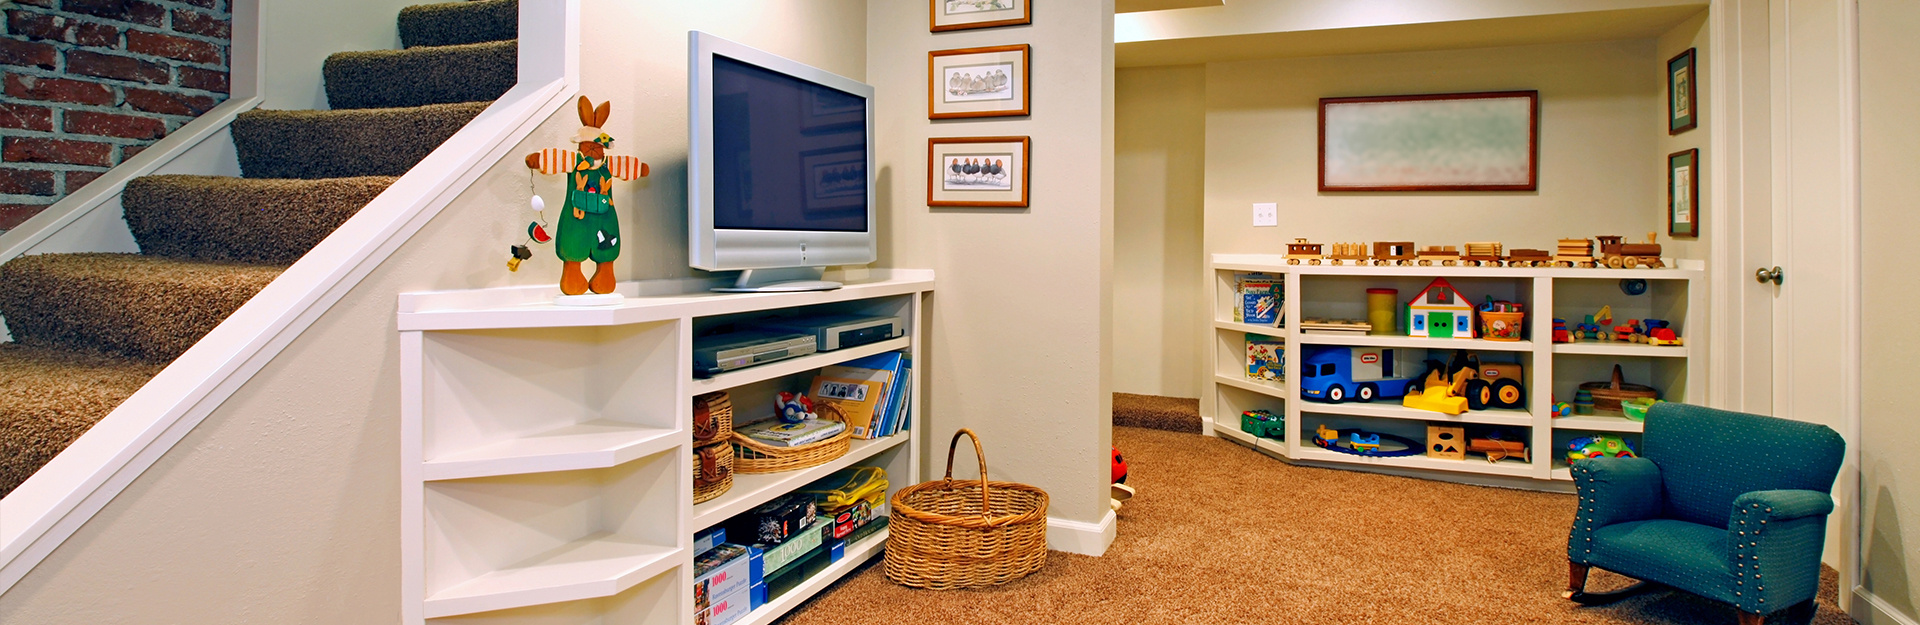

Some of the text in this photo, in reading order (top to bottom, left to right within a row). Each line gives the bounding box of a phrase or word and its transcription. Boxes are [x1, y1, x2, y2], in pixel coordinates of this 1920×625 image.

[780, 539, 803, 563] 1000
[712, 571, 727, 587] 1000
[712, 584, 736, 600] Ravensburger
[736, 578, 747, 587] Puzzle
[713, 600, 728, 617] 1000
